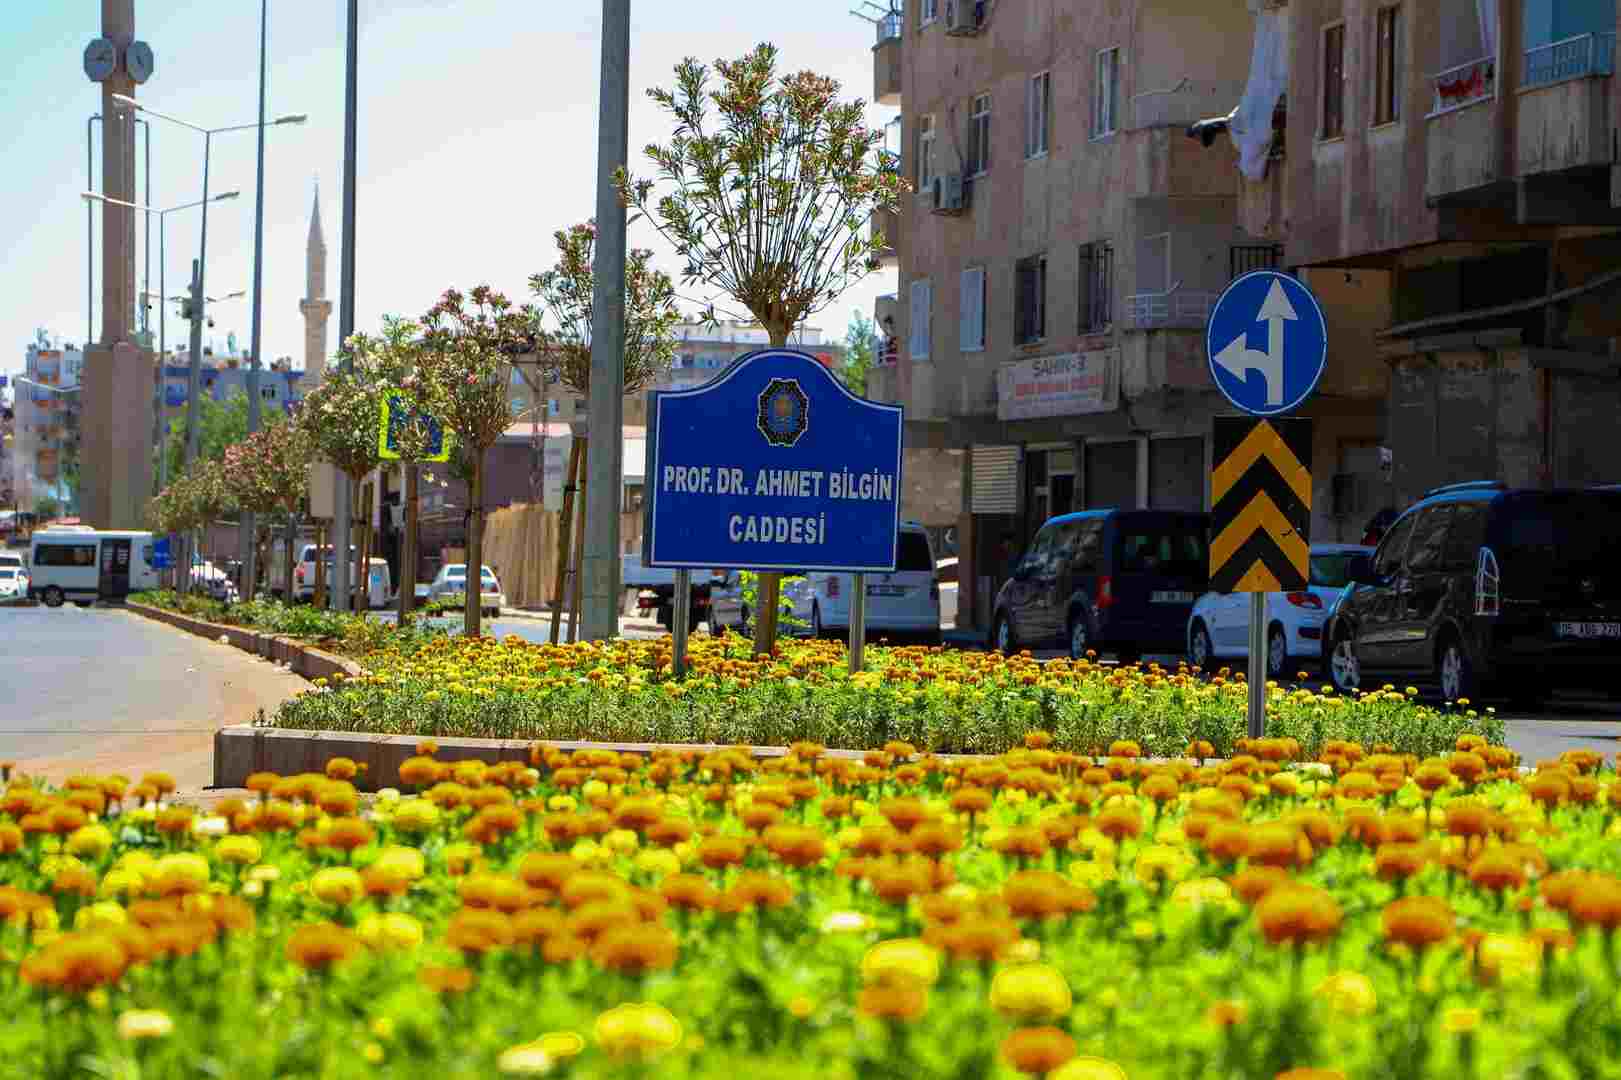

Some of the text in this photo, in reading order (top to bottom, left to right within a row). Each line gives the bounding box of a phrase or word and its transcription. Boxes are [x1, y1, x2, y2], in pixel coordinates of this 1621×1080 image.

[663, 466, 893, 500] PROF. DR. AHMET BİLGİN
[729, 512, 825, 545] CADDESİ
